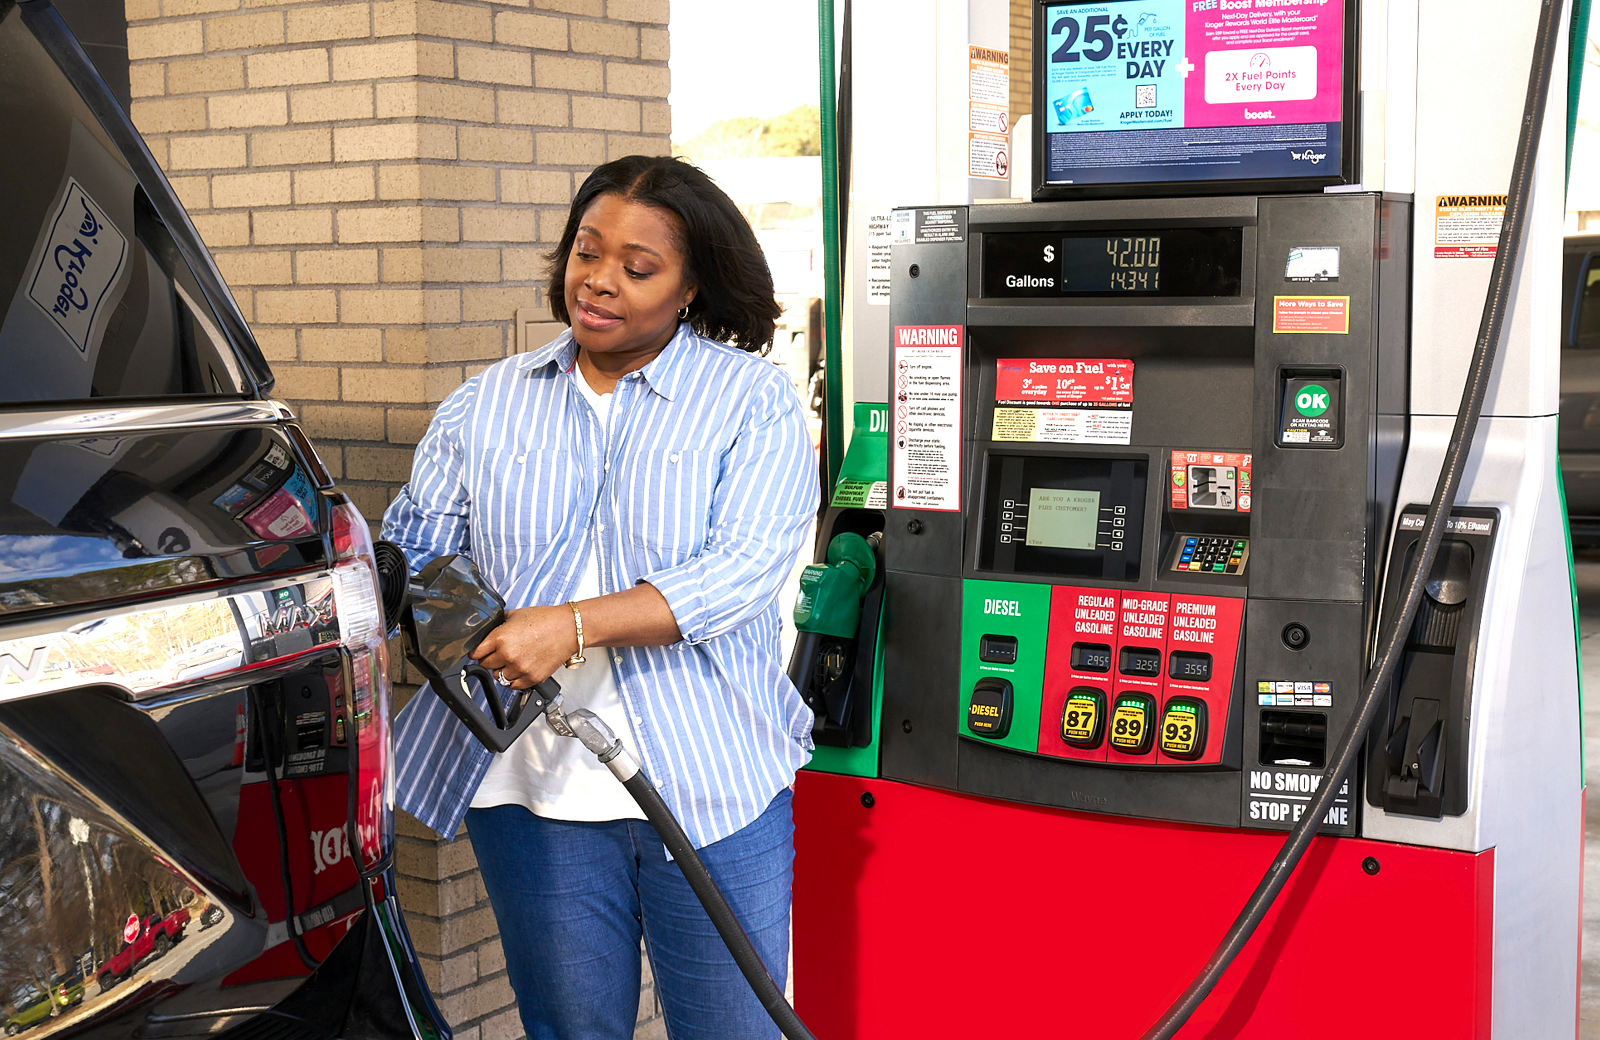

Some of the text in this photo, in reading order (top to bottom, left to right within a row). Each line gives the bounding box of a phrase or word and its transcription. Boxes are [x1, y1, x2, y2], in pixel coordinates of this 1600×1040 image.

[1193, 0, 1218, 12] FREE
[1220, 0, 1252, 10] Boost
[1222, 12, 1248, 20] Next-Day
[975, 48, 1009, 64] WARNING
[1117, 39, 1175, 59] EVERY
[1126, 59, 1166, 79] DAY
[1225, 69, 1296, 82] 2X Fuel Points
[1236, 81, 1286, 92] Every Day
[1120, 110, 1173, 119] APPLY TODAY!
[1301, 149, 1327, 164] Kroger
[1043, 238, 1161, 268] $ 42.00
[1005, 271, 1159, 290] Gallons 14.341
[899, 328, 958, 345] WARNING
[1029, 361, 1057, 374] Save
[1058, 365, 1074, 374] on
[1075, 362, 1104, 374] Fuel
[1297, 393, 1327, 409] OK
[1403, 518, 1415, 527] May
[1454, 521, 1467, 530] 10%
[1468, 521, 1490, 531] Ethanol
[984, 599, 1021, 616] DIESEL
[1078, 595, 1114, 608] REGULAR
[1122, 598, 1168, 612] MID-GRADE
[1075, 608, 1115, 621] UNLEADED
[1176, 602, 1216, 616] PREMIUM
[1123, 612, 1165, 625] UNLEADED
[1173, 616, 1216, 629] UNLEADED
[1075, 621, 1113, 635] GASOLINE
[1123, 625, 1163, 639] GASOLINE
[1173, 630, 1215, 643] GASOLINE
[971, 704, 999, 717] DIESEL
[1067, 711, 1092, 728] 87
[1115, 718, 1141, 736] 89
[1166, 723, 1192, 742] 93
[1250, 771, 1348, 795] NO SMOKG
[1071, 790, 1107, 805] Wayne
[1250, 801, 1348, 825] STOP ENE
